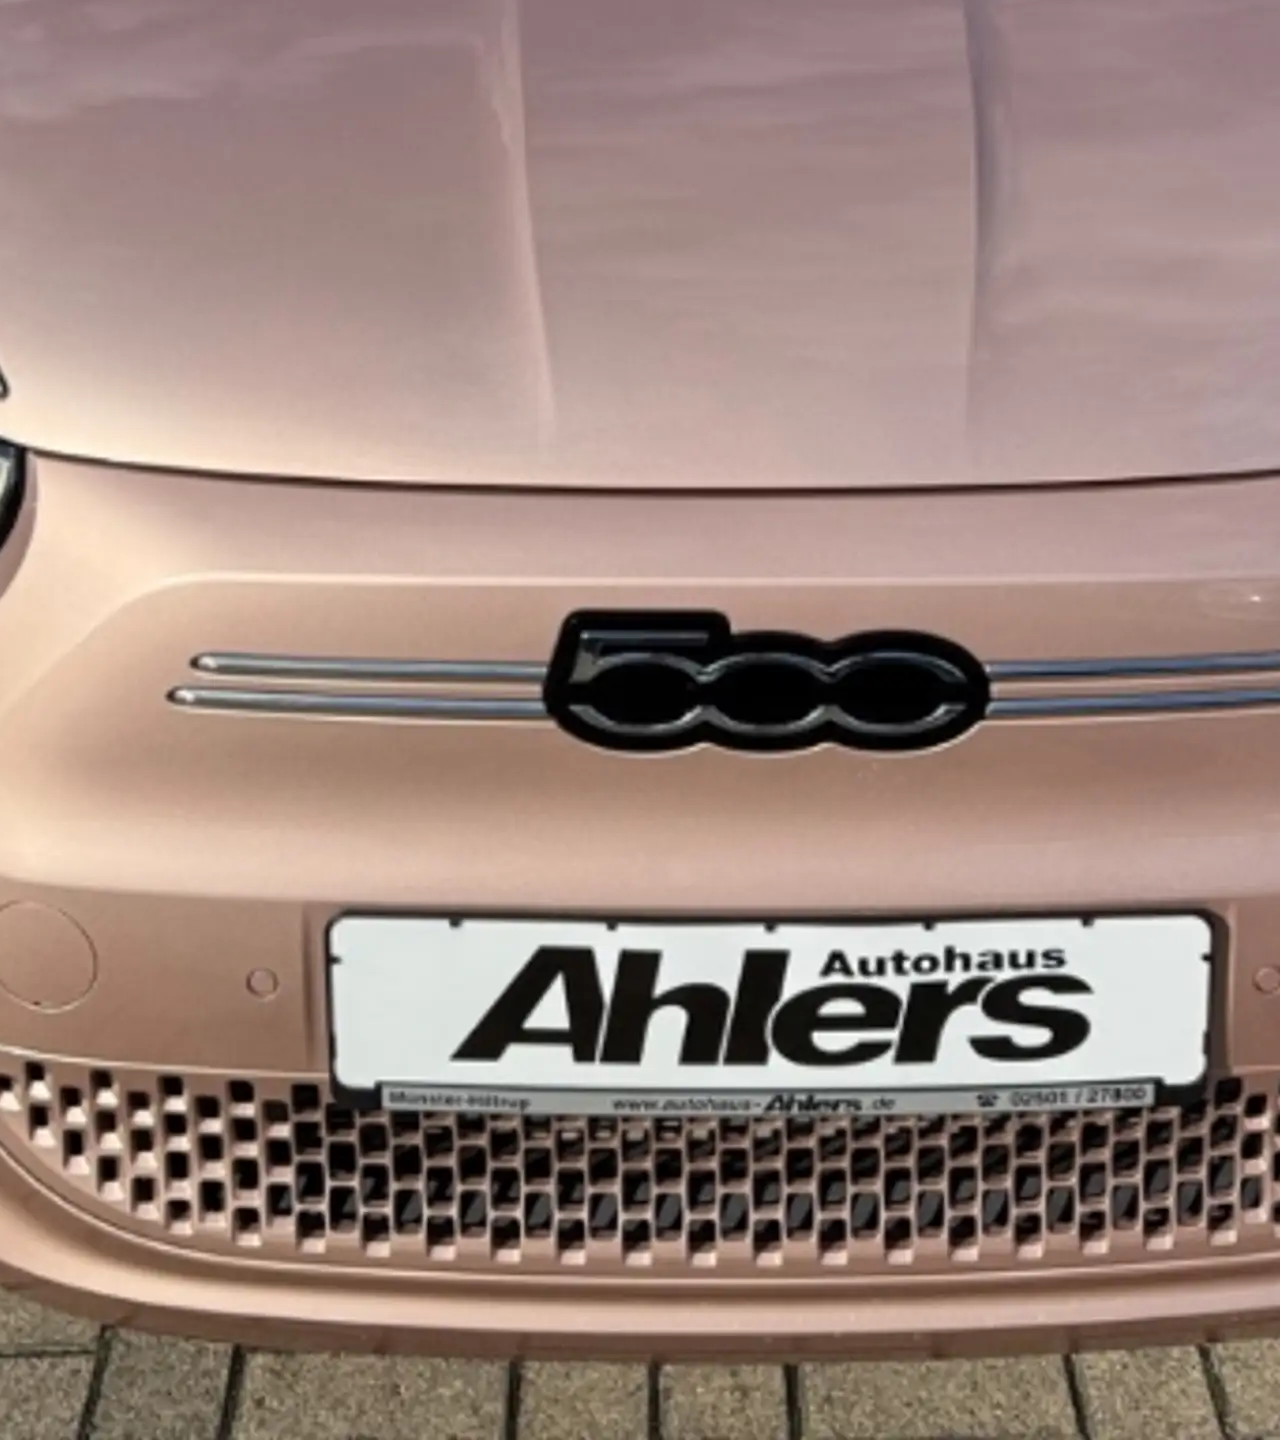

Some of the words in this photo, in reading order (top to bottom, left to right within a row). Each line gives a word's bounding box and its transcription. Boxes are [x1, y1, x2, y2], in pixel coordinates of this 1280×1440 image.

[558, 620, 978, 744] 500
[449, 944, 1094, 1067] Ahlers
[819, 945, 1067, 978] Autohaus
